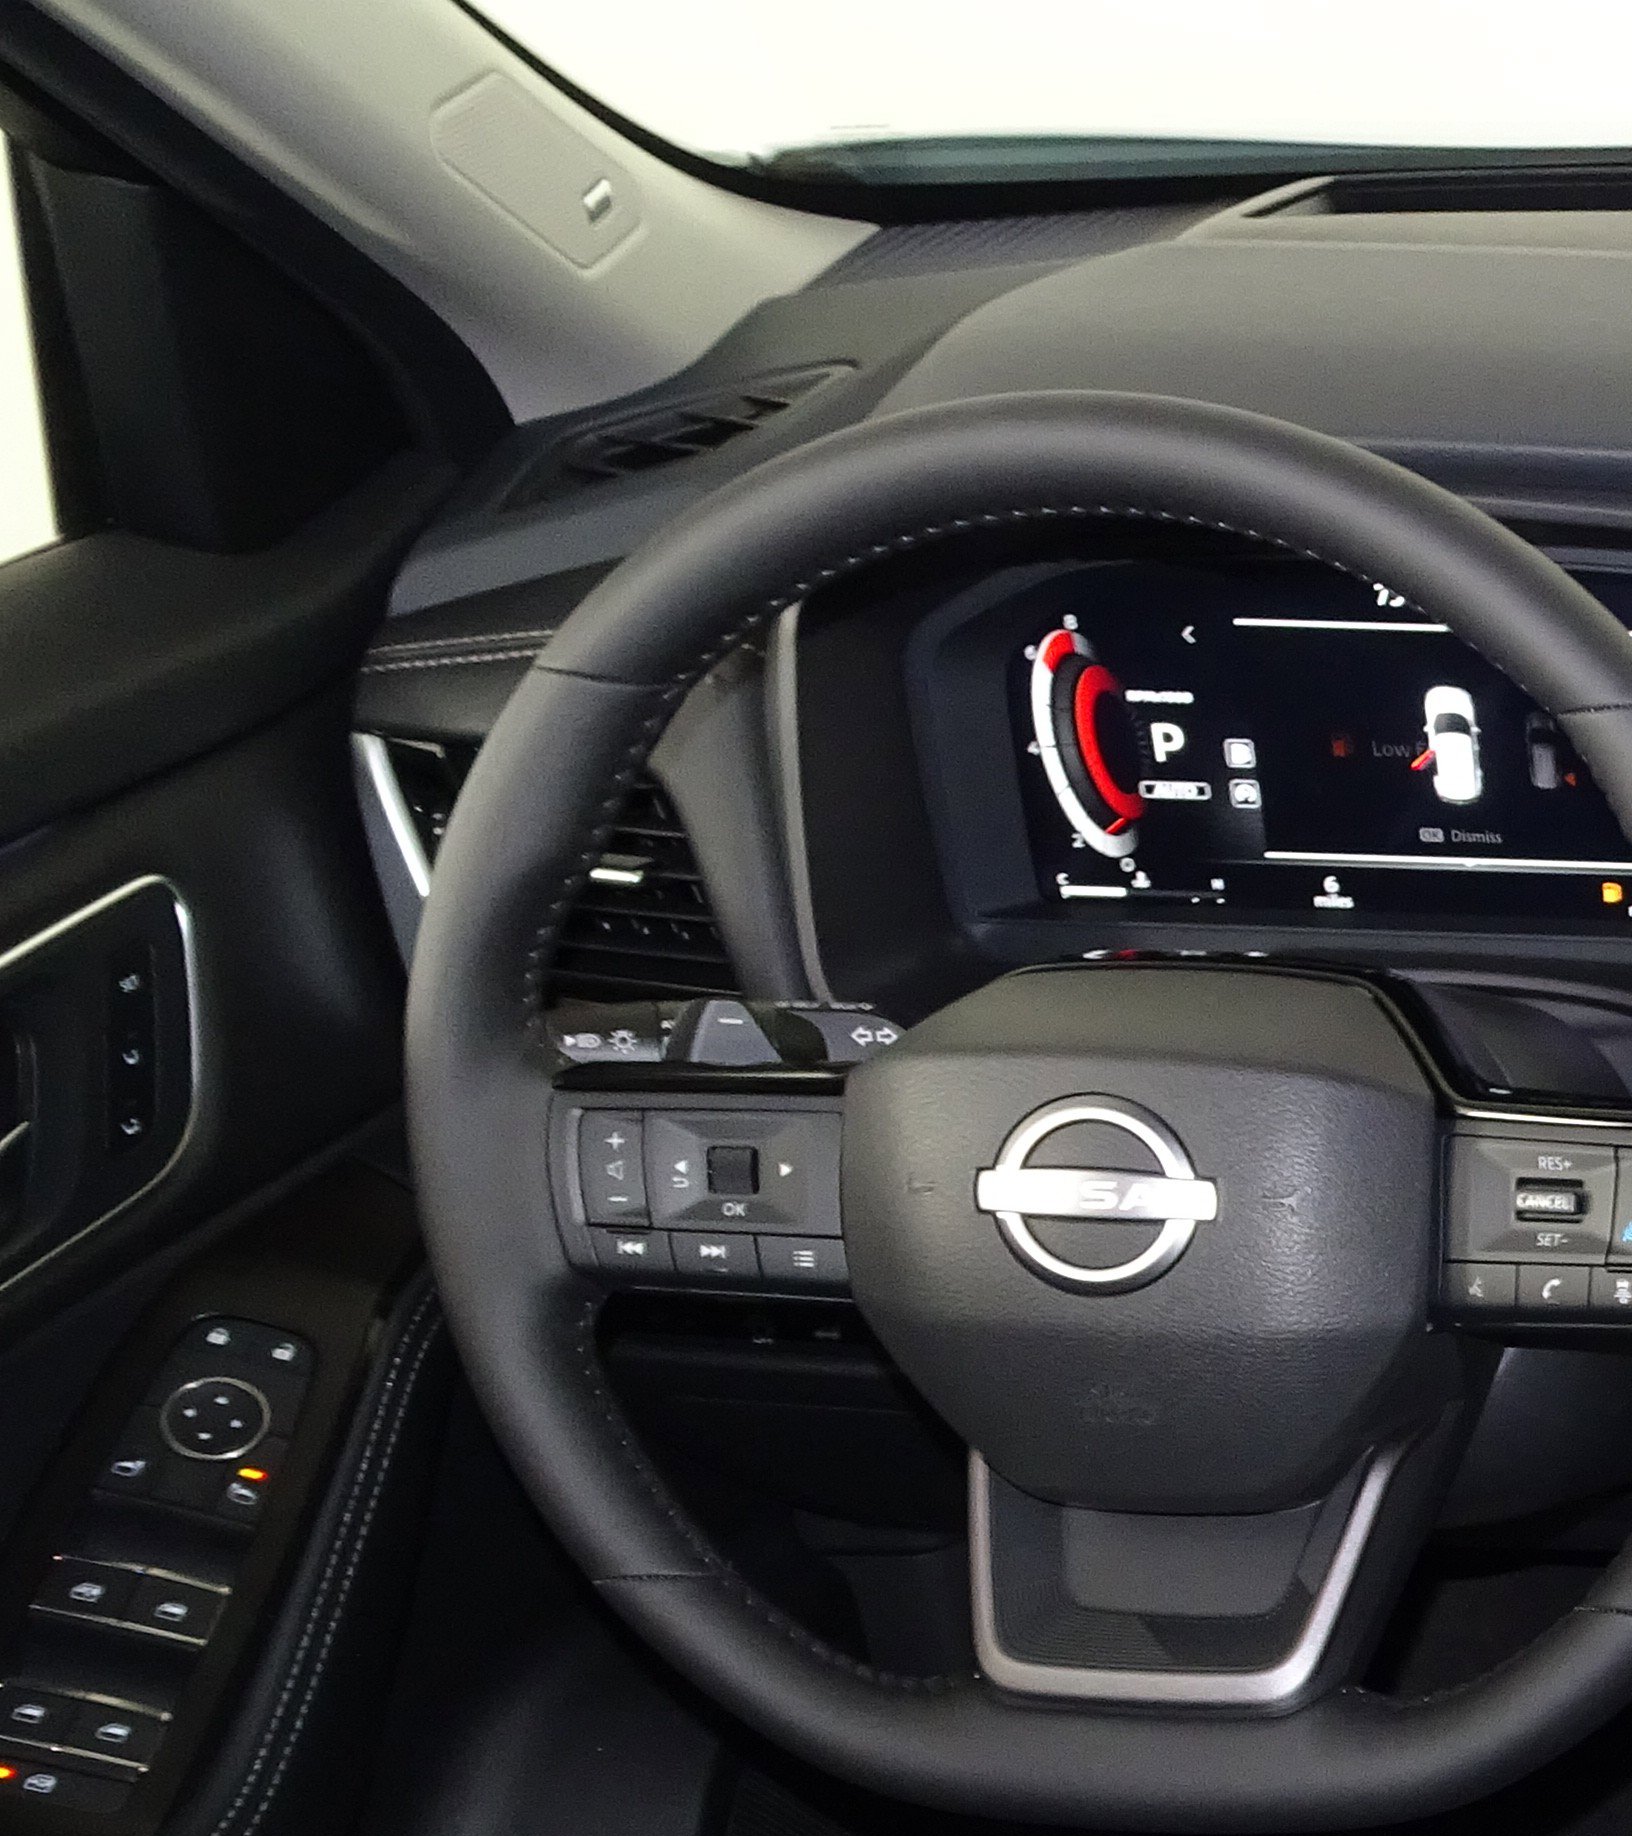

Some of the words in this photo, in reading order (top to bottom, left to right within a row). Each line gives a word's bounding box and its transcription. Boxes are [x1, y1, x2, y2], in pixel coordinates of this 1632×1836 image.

[1151, 722, 1185, 763] P
[1371, 741, 1410, 758] Low
[1451, 829, 1503, 845] Dismiss
[1538, 1156, 1573, 1171] RES+
[721, 1202, 746, 1217] OK
